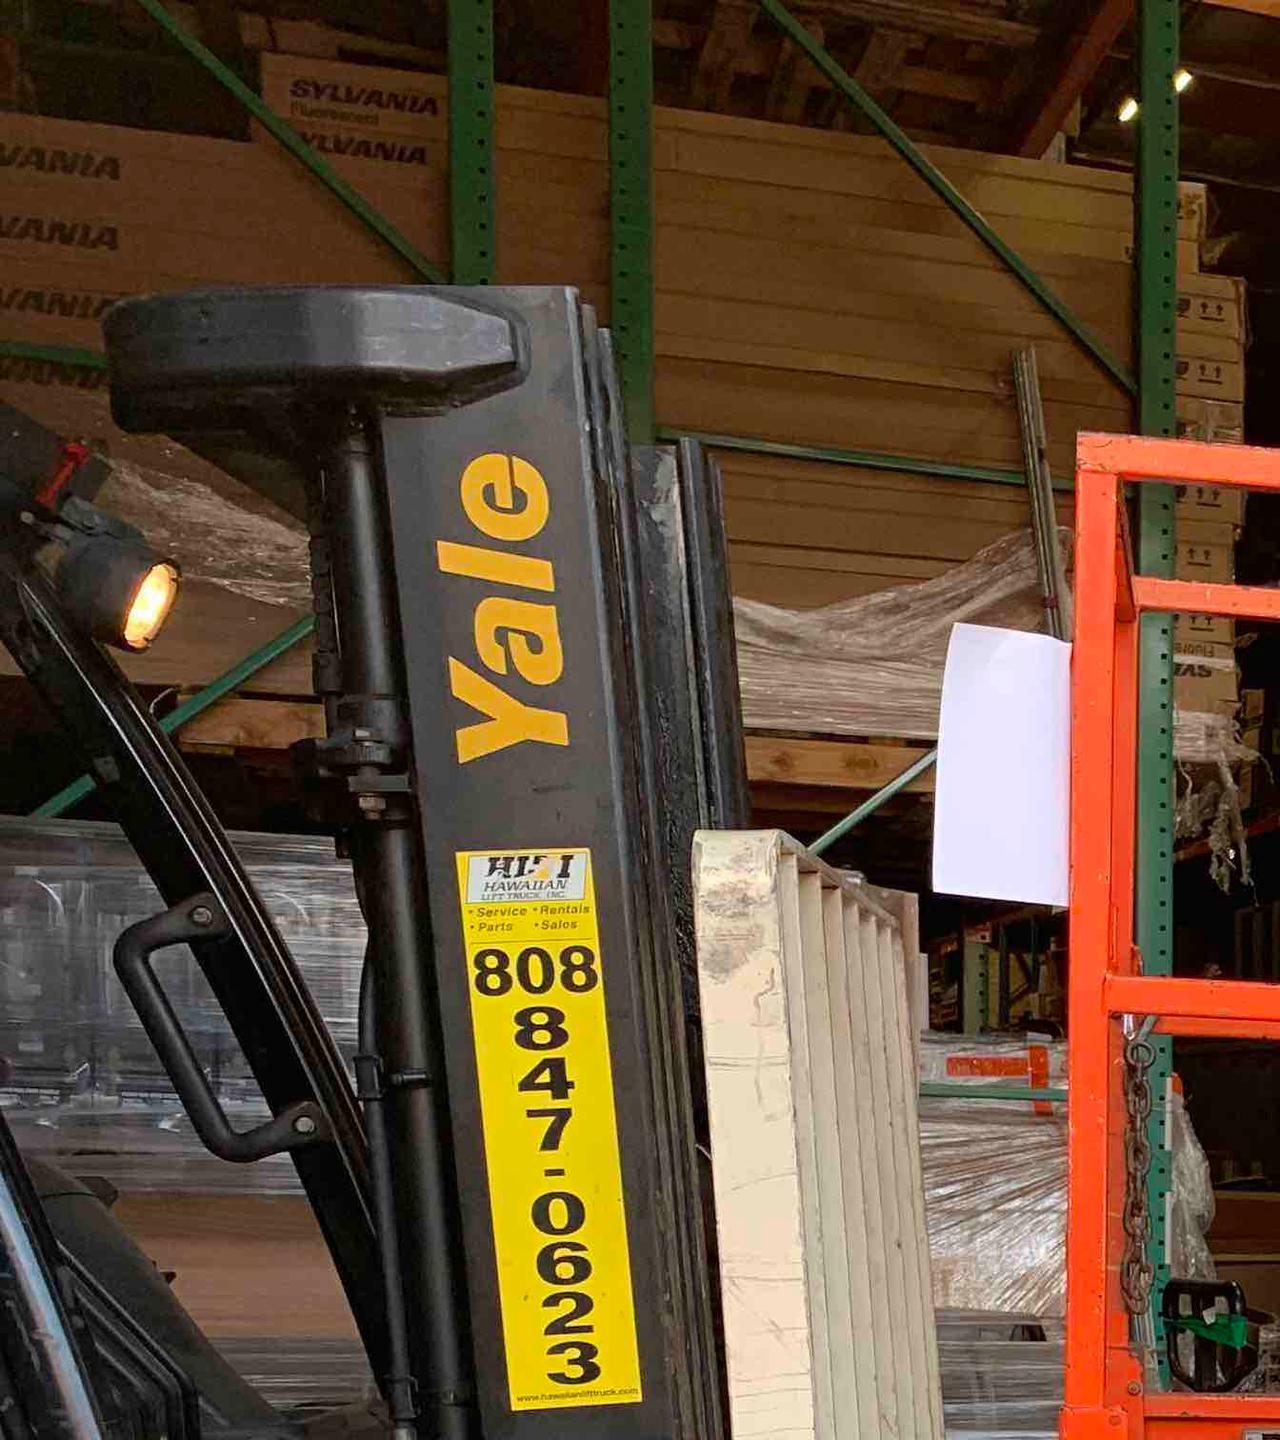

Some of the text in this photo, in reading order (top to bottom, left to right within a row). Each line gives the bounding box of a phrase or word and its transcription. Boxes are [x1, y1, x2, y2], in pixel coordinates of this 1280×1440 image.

[289, 78, 439, 116] SYLVANIA
[436, 452, 570, 765] Yale
[483, 879, 568, 893] HAWAIIAN
[476, 903, 591, 918] Service Rentals
[478, 921, 513, 932] Parts
[473, 946, 599, 996] 808
